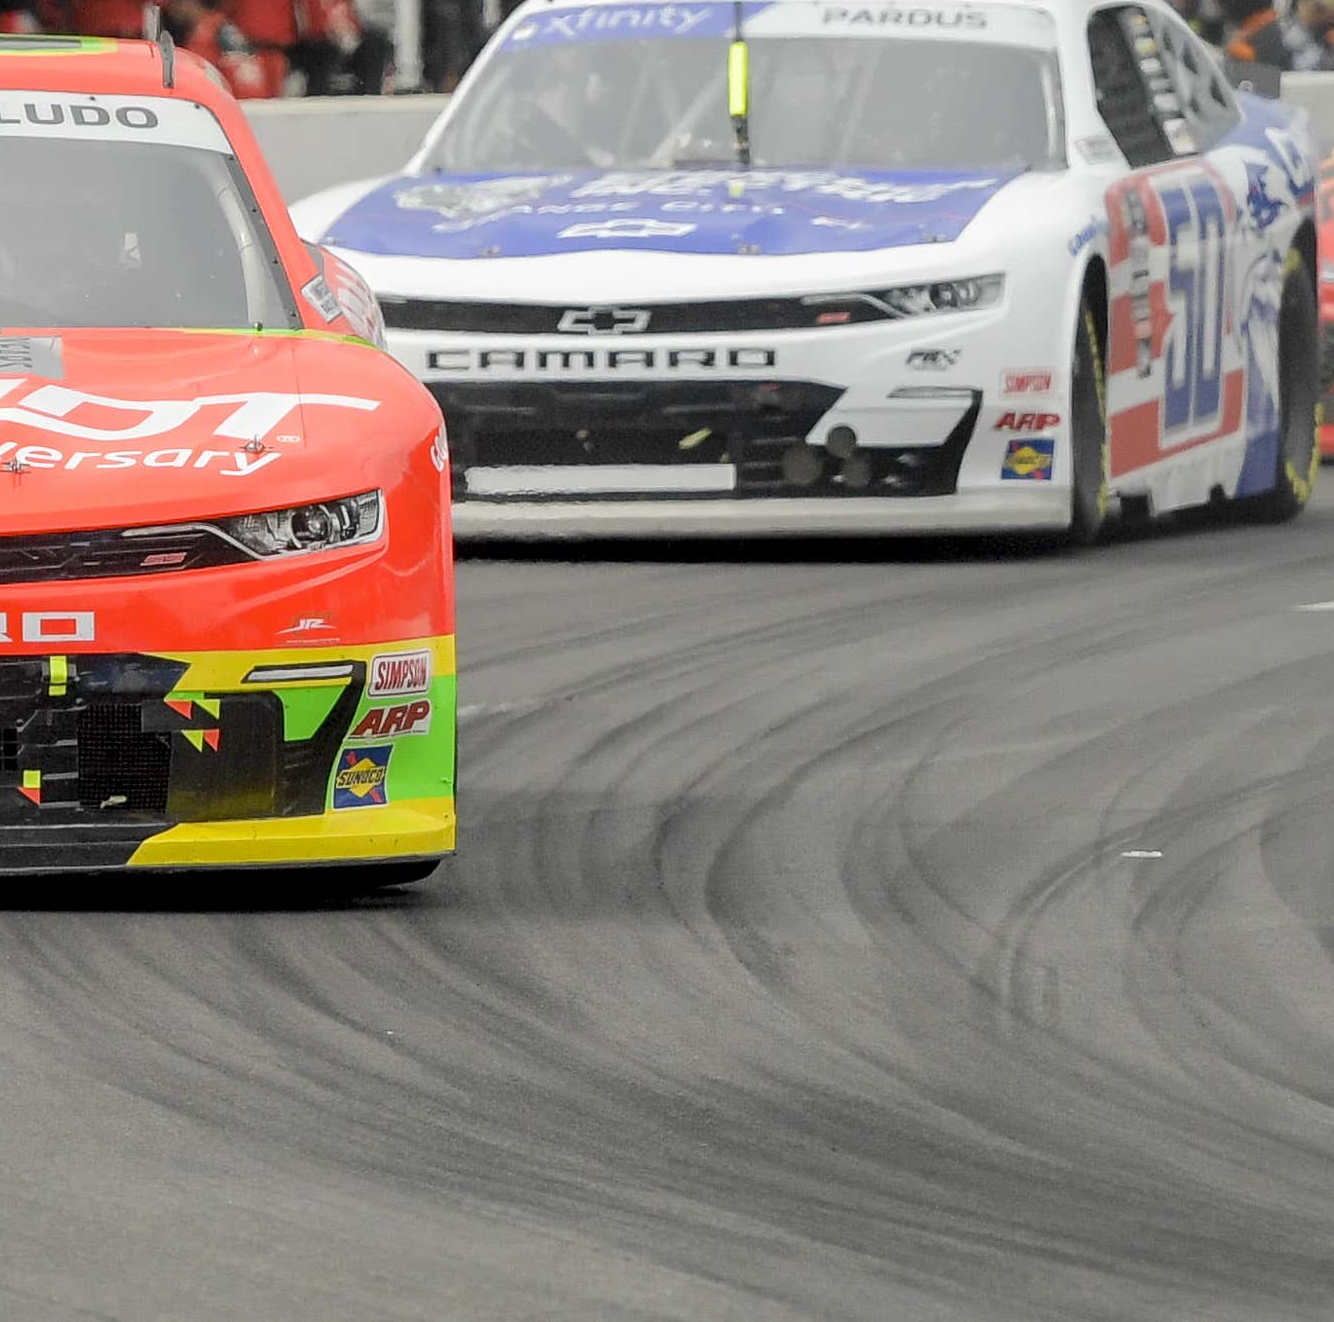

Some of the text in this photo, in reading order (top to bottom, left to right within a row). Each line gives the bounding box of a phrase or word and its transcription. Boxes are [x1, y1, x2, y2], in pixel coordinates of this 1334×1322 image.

[542, 4, 713, 38] xfinity
[822, 7, 988, 30] PARDUS
[1157, 174, 1227, 442] 50
[426, 348, 777, 372] CAMARO
[994, 412, 1062, 432] ARP
[374, 656, 428, 692] SIMPSON
[350, 699, 431, 736] ARP
[336, 766, 386, 788] SUNOCO
